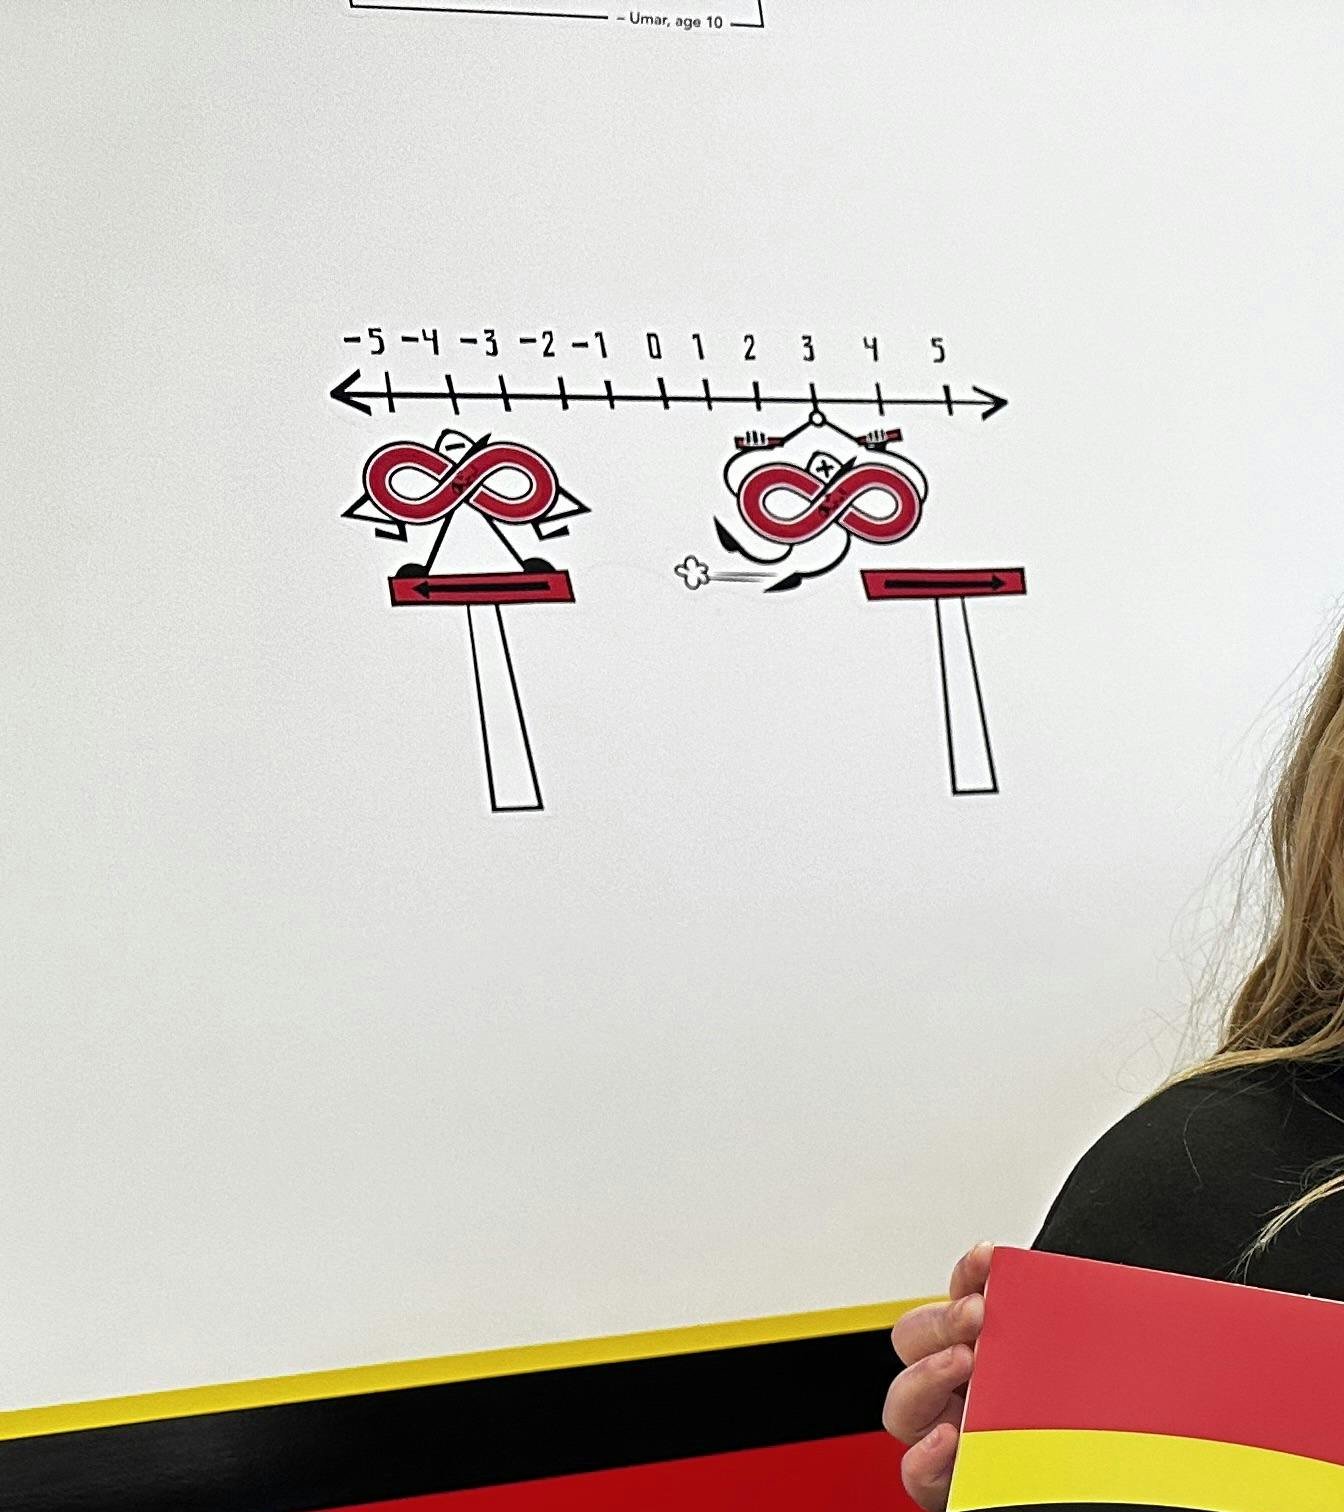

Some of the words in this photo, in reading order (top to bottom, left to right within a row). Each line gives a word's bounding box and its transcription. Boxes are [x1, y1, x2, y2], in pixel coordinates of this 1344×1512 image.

[630, 12, 670, 27] Umar,
[675, 17, 701, 30] age
[707, 16, 722, 29] 10
[343, 327, 385, 355] -5
[401, 328, 439, 356] -4
[460, 328, 499, 357] -3
[519, 330, 555, 358] -2
[571, 331, 607, 358] -1
[646, 332, 662, 360] 0
[692, 333, 704, 360] 1
[744, 334, 756, 361] 2
[801, 335, 815, 362] 3
[863, 336, 879, 363] 4
[931, 336, 946, 364] 5
